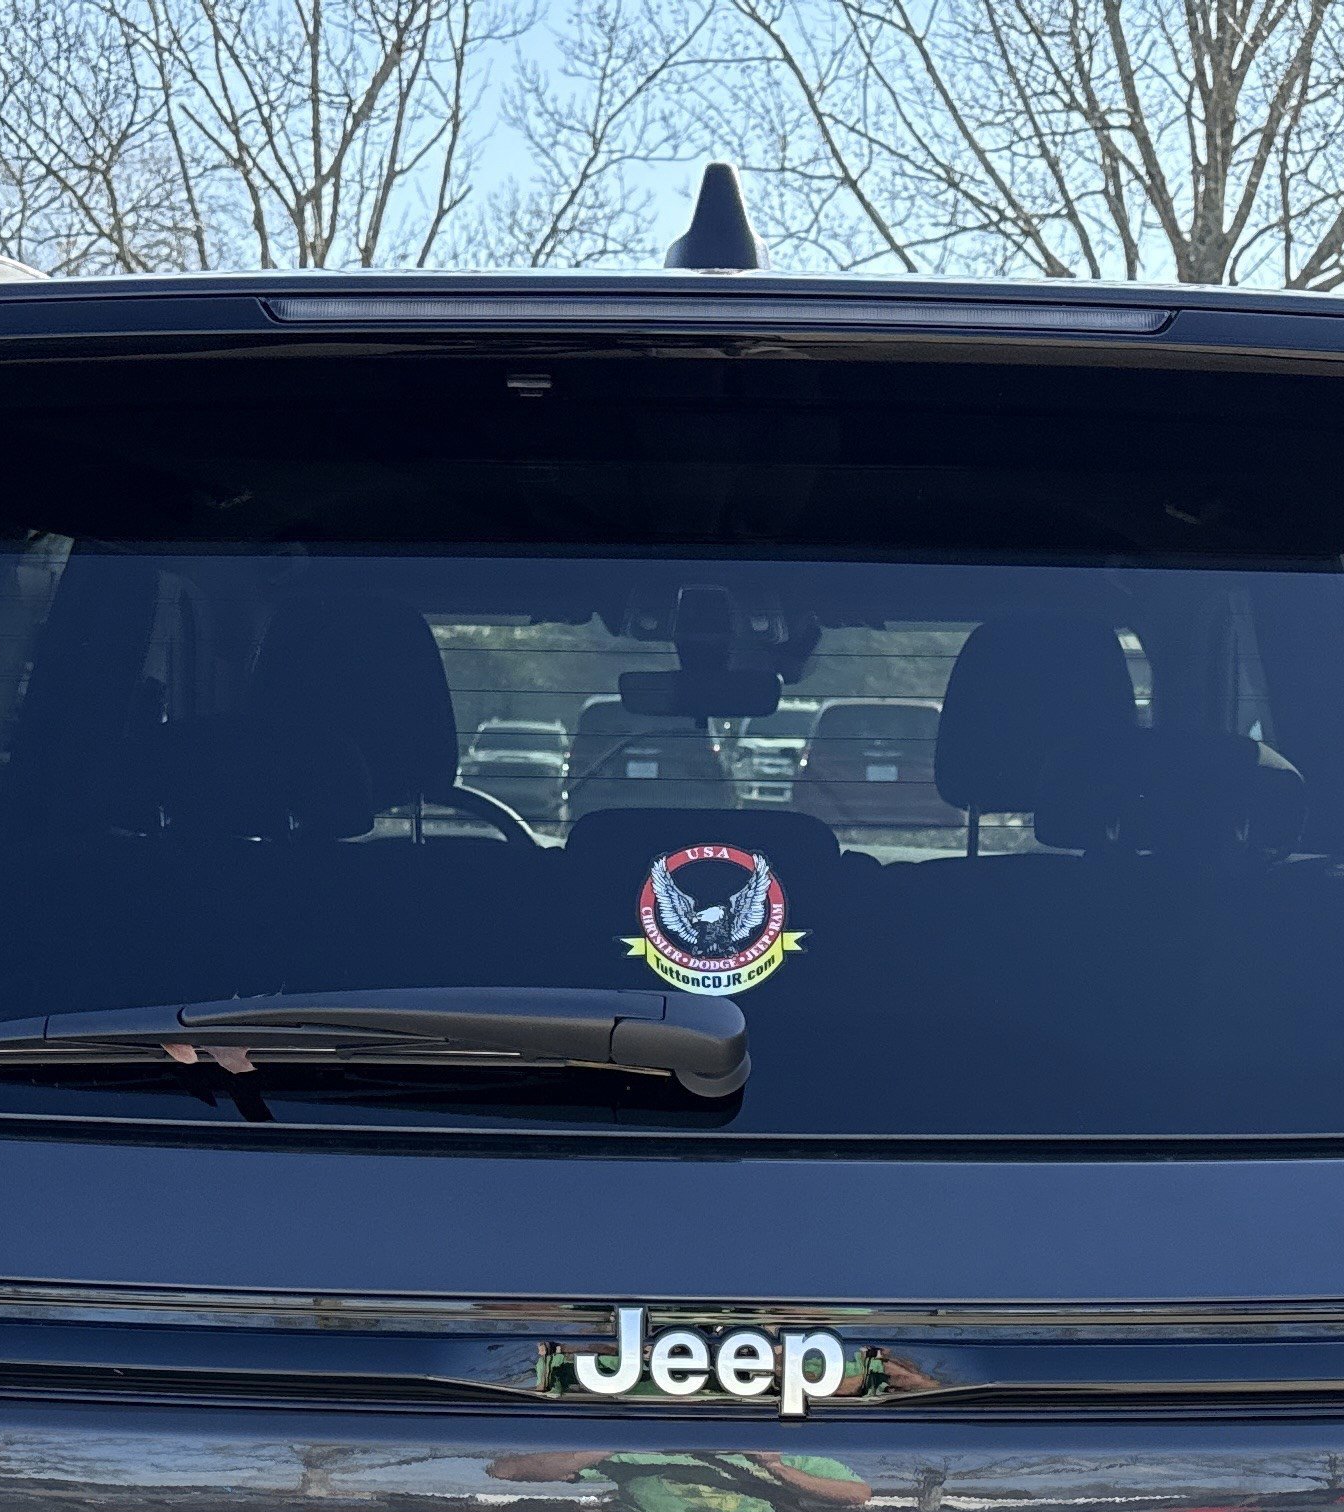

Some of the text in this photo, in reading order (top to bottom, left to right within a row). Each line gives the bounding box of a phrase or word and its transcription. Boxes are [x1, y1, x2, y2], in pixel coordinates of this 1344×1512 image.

[685, 847, 730, 860] USA
[641, 903, 783, 971] CHRYSLER DODGE JEEP RAM
[654, 954, 775, 988] TuttonCDJR.com
[574, 1307, 845, 1414] Jeep
